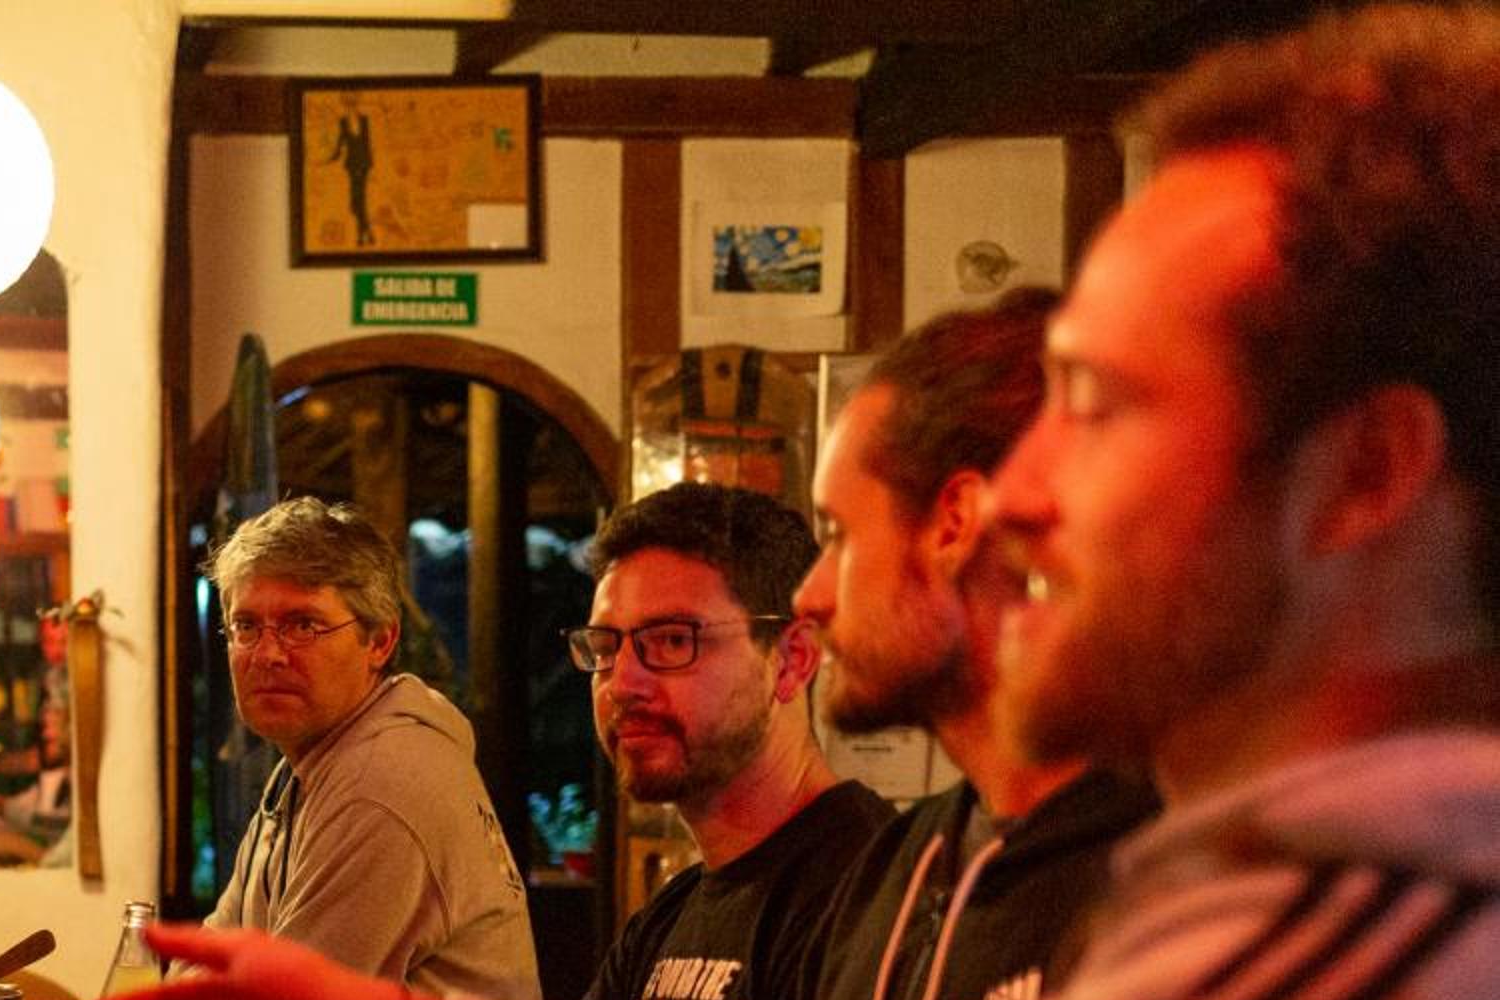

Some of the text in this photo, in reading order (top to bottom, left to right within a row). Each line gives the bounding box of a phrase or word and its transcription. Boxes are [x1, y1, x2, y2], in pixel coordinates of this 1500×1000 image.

[373, 277, 456, 297] SALIDA DE
[362, 302, 469, 321] EMERGENCIA
